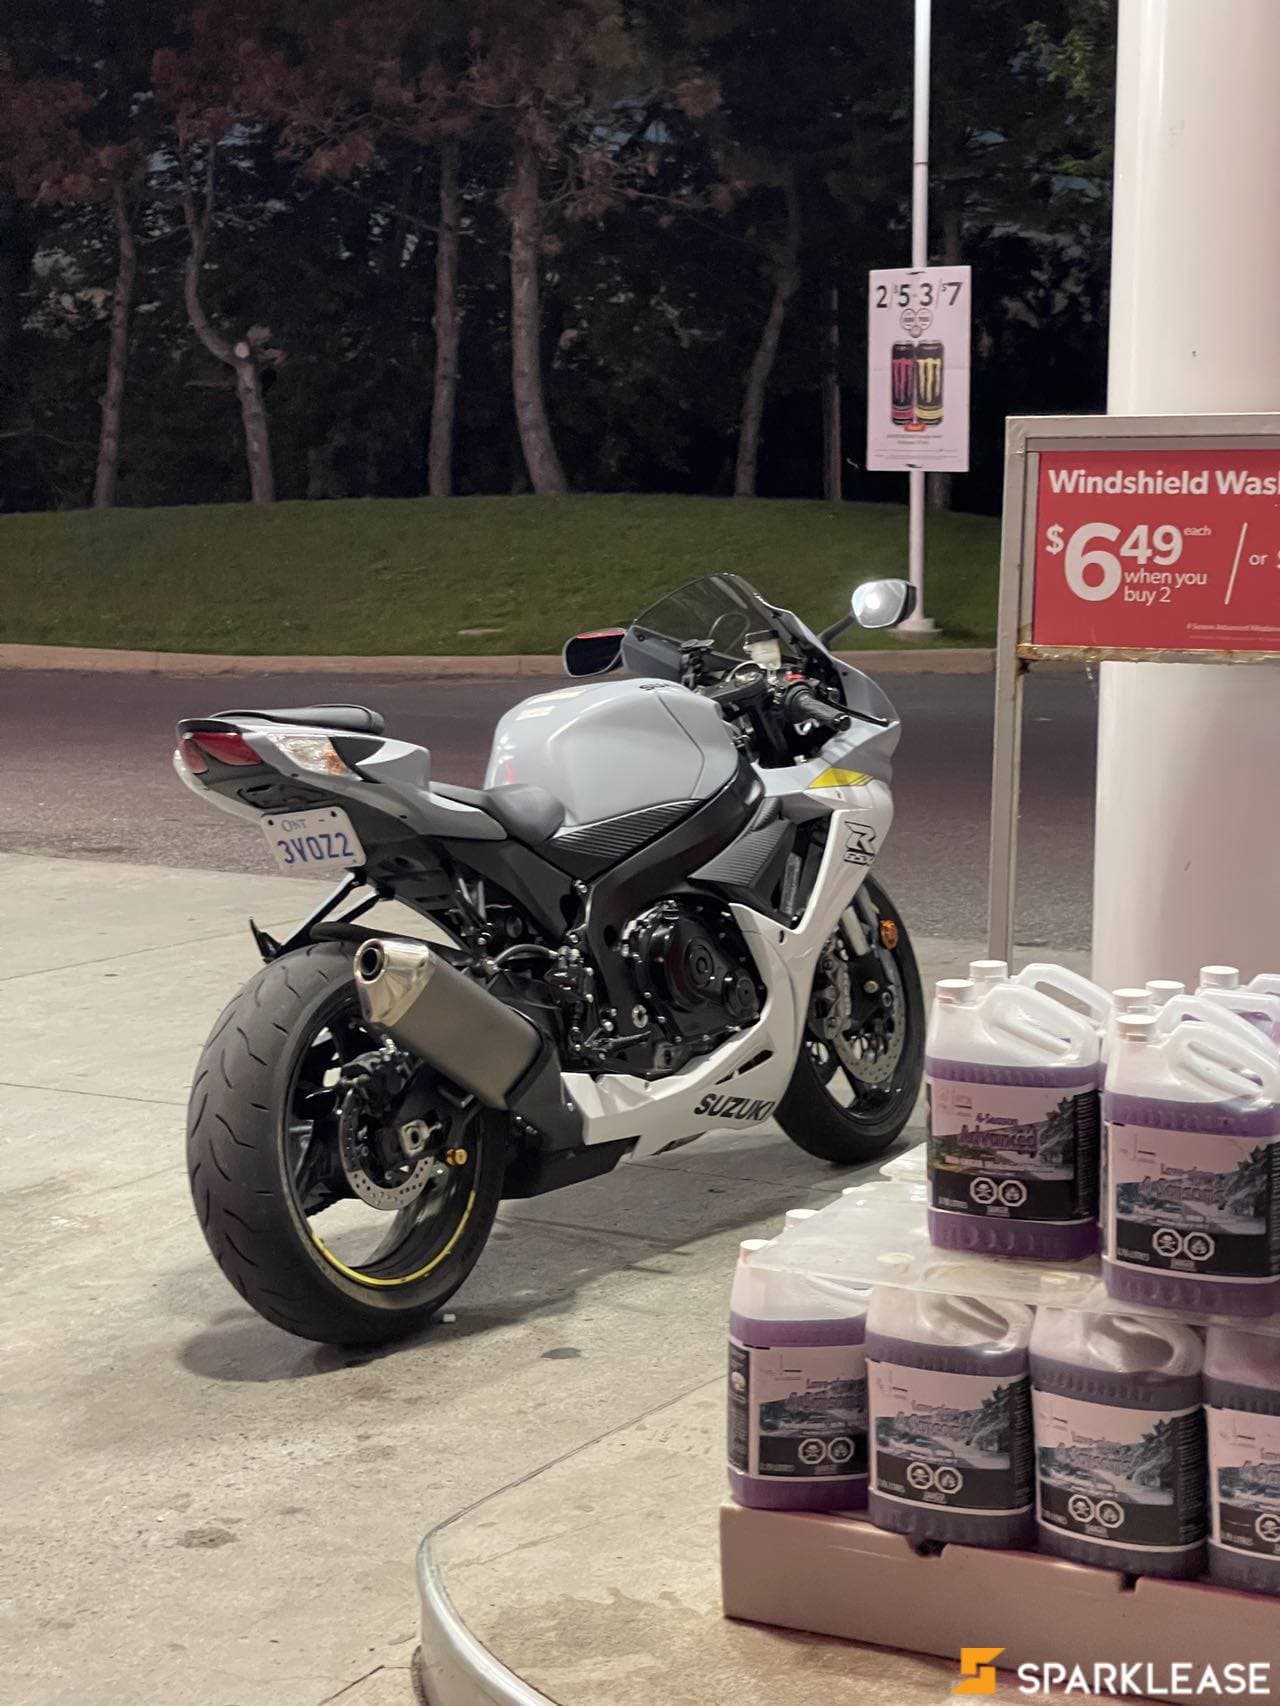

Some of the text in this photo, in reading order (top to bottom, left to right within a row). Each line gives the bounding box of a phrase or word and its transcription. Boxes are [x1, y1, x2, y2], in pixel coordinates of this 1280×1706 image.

[1048, 469, 1280, 495] Windshield Was
[1183, 525, 1211, 537] each
[1249, 554, 1269, 566] or
[1124, 568, 1208, 588] when you
[1124, 586, 1171, 606] buy 2
[694, 1093, 776, 1121] SUZUKI
